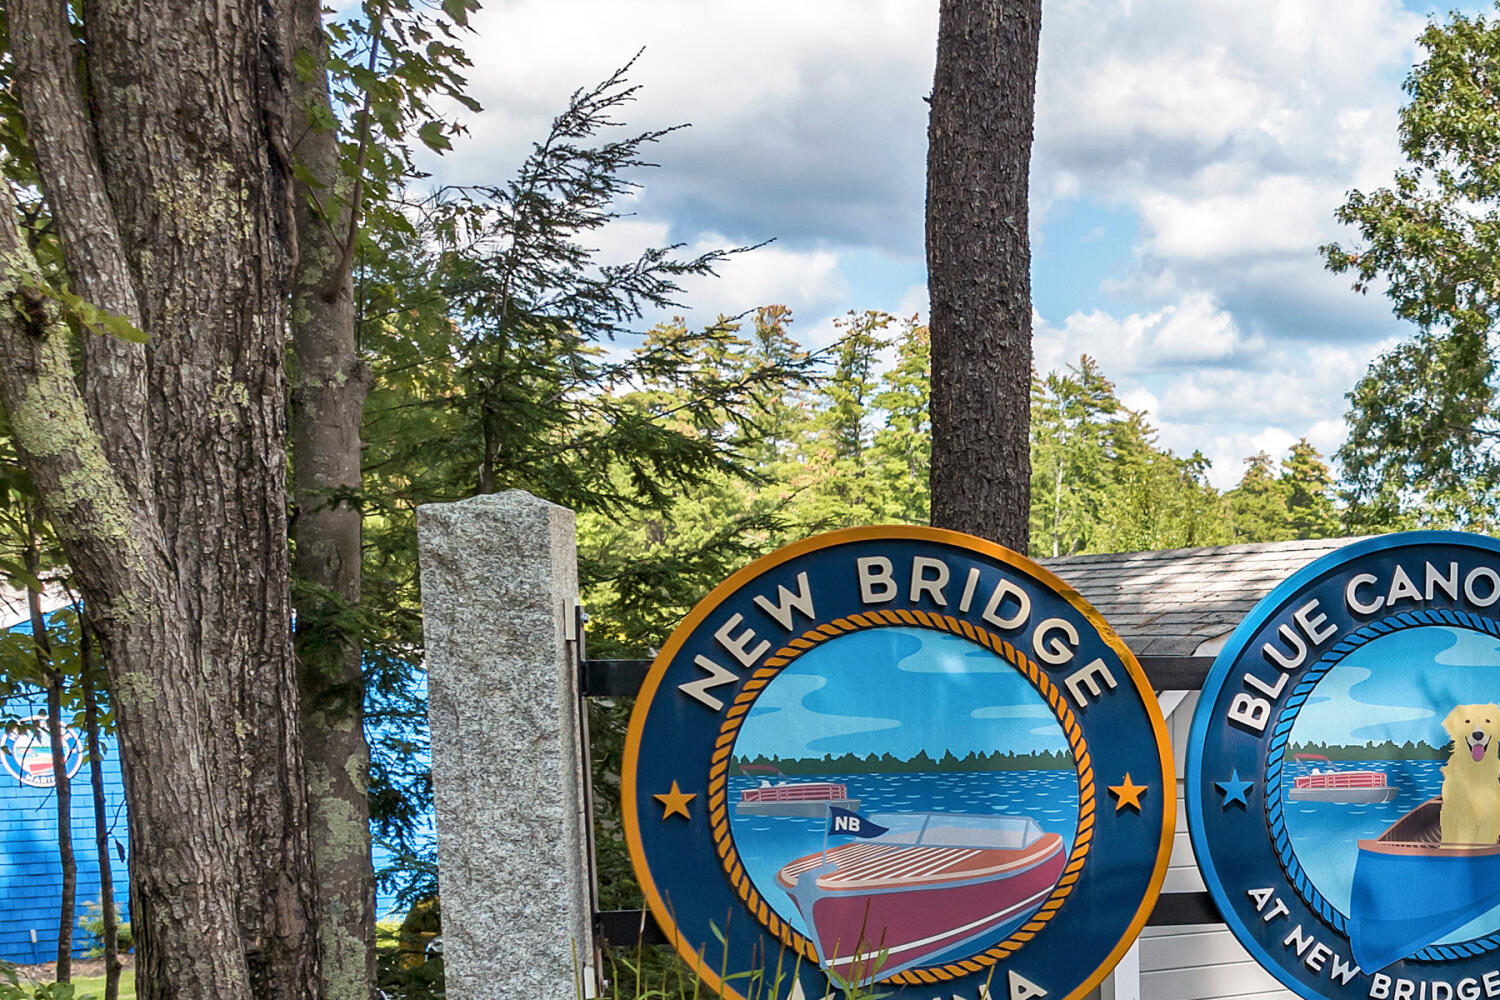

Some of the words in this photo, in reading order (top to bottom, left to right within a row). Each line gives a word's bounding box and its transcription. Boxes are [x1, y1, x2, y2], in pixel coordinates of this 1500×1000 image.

[678, 571, 817, 711] NEW
[857, 556, 1118, 708] BRIDGE
[1227, 598, 1338, 731] BLUE
[834, 815, 860, 832] NB
[1248, 887, 1290, 922] AT
[1283, 924, 1361, 985] NEW
